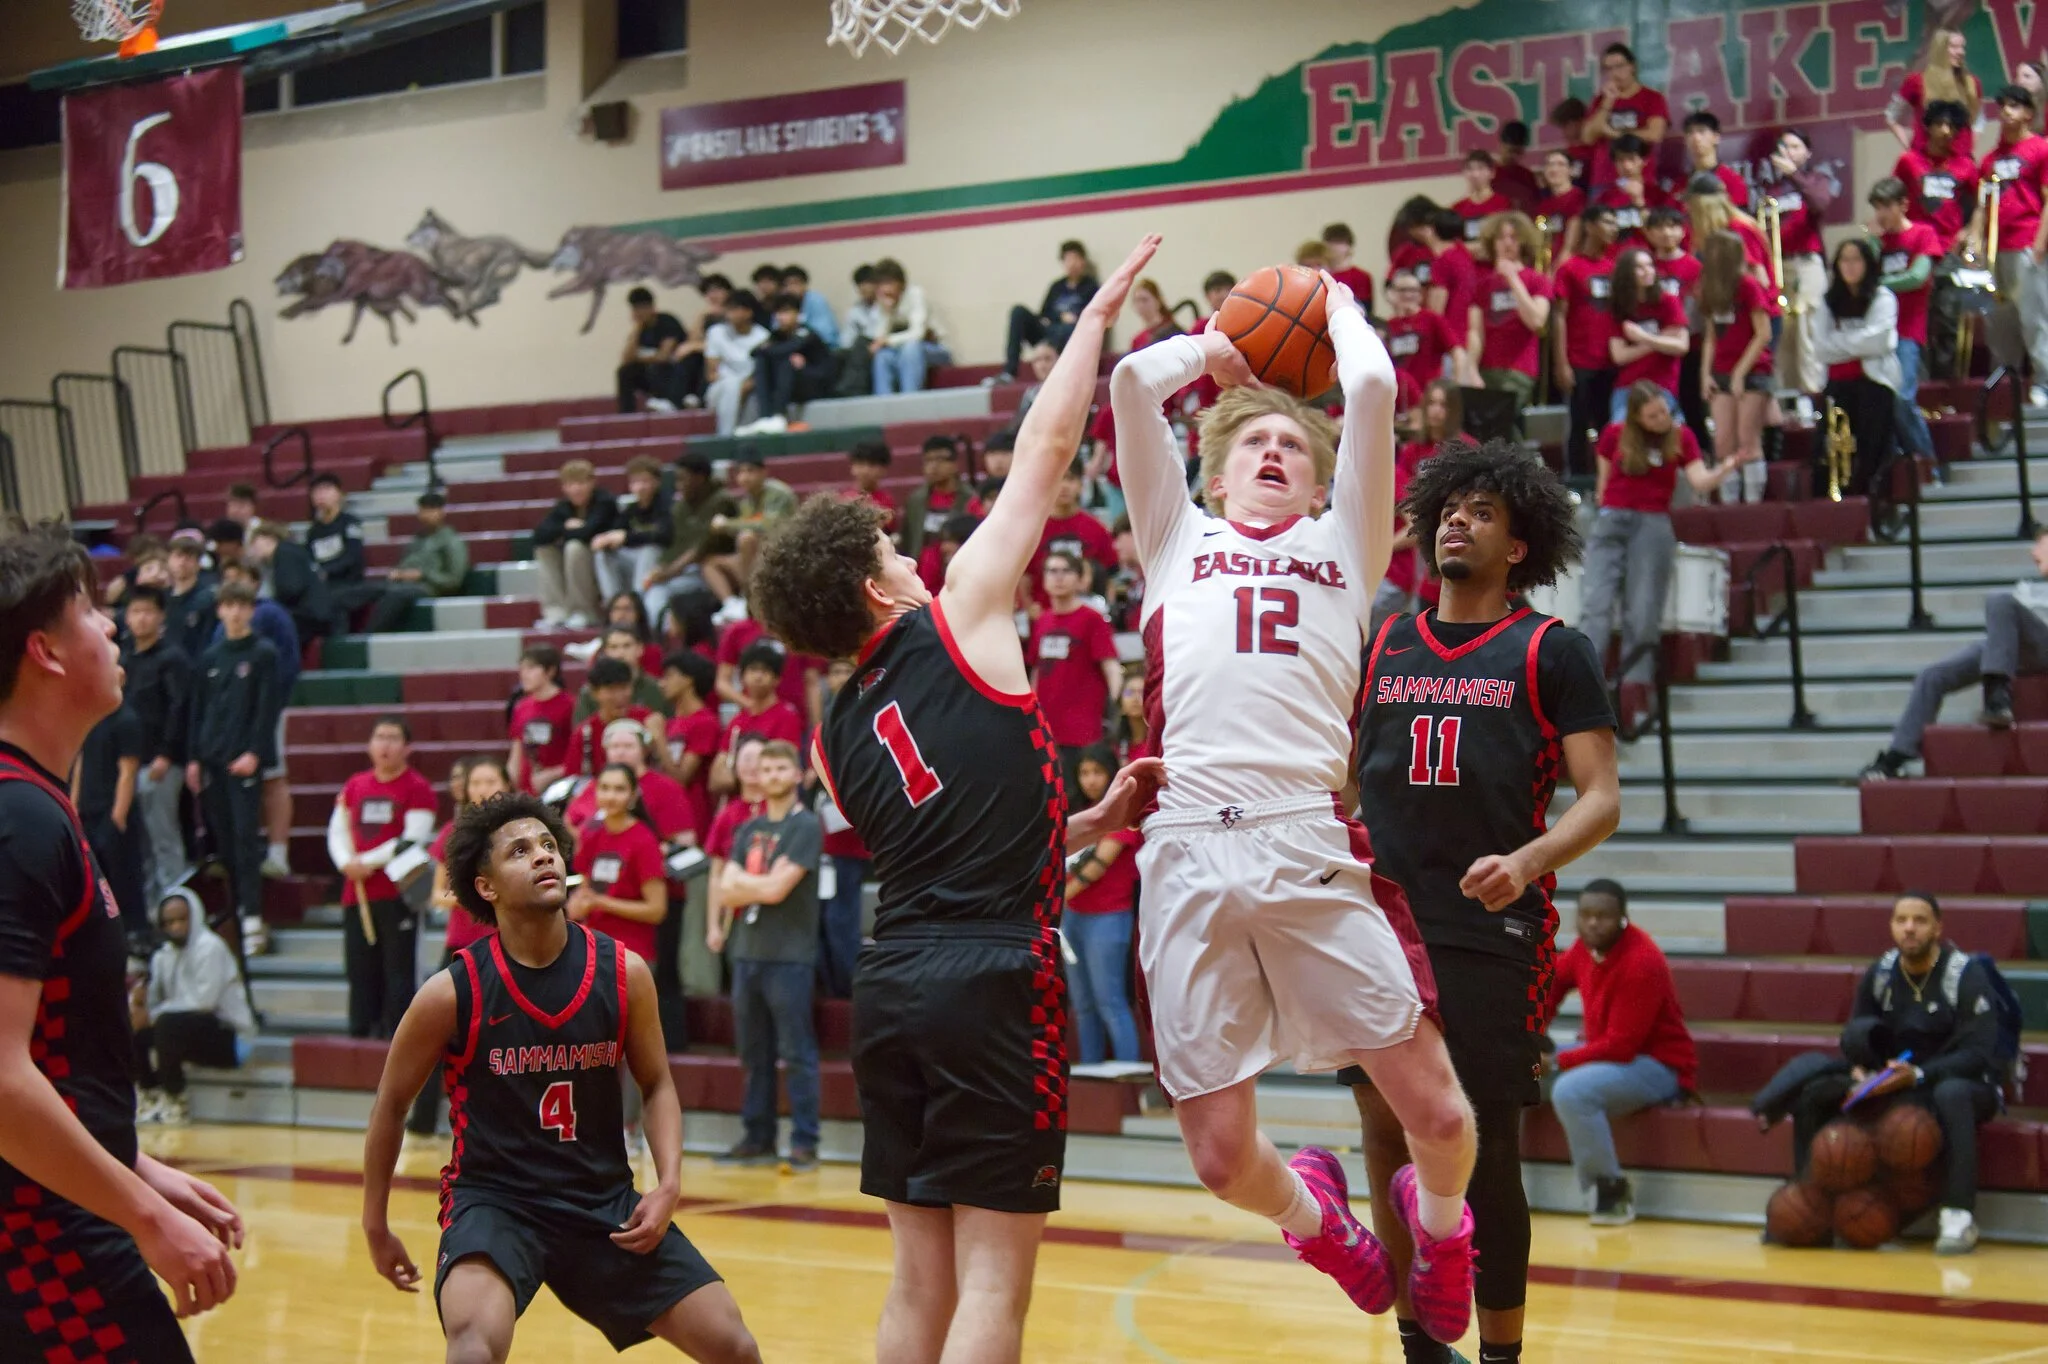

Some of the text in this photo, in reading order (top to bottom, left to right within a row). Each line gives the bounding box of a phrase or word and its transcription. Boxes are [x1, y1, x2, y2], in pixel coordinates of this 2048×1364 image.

[784, 111, 870, 151] STUDENTS
[120, 110, 179, 248] 6
[1191, 551, 1347, 590] EASTLAKE
[1233, 586, 1299, 657] 12
[1377, 675, 1515, 708] SAMMAMISH
[872, 700, 944, 809] 1
[1408, 714, 1462, 786] 11
[489, 1040, 617, 1076] SAMMAMISH
[539, 1081, 577, 1143] 4
